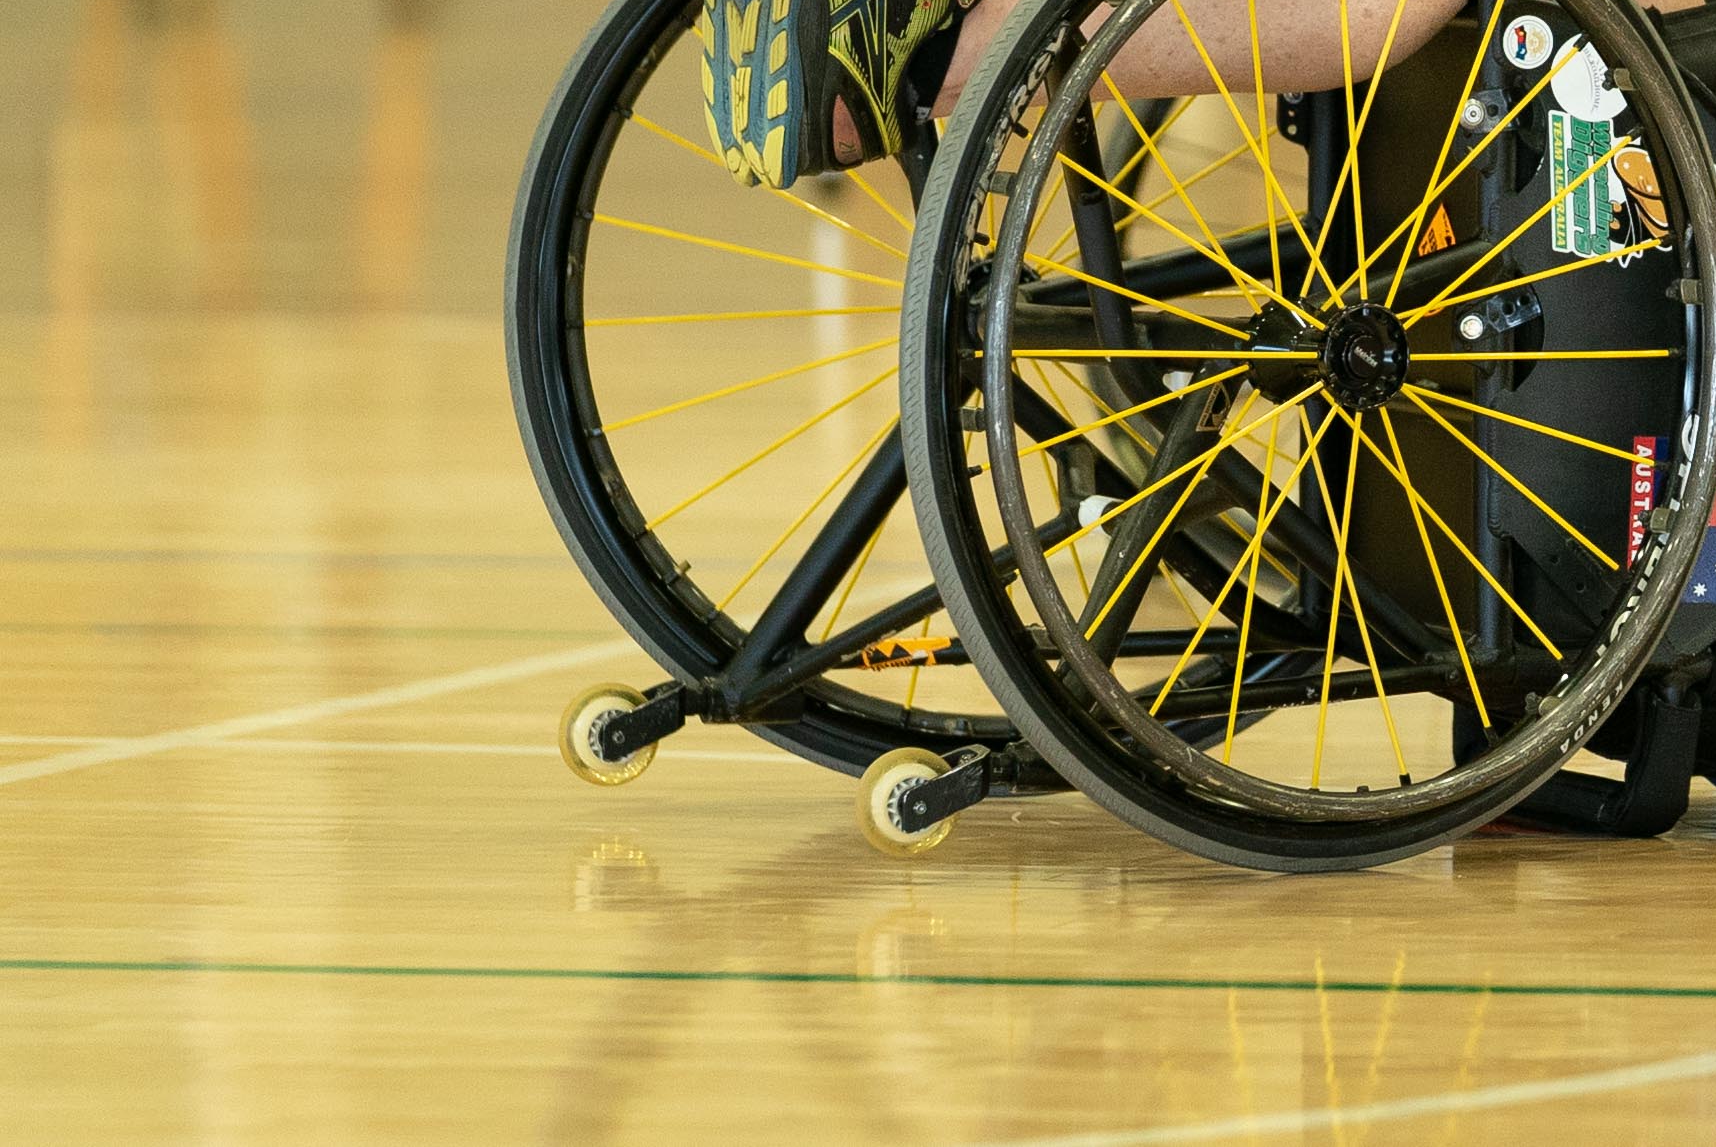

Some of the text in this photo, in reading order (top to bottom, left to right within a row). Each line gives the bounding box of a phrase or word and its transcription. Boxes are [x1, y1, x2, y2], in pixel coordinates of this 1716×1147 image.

[1553, 120, 1566, 246] TEAM AUSRALIA
[1567, 116, 1593, 254] Diggers
[1560, 681, 1623, 754] KENDA
